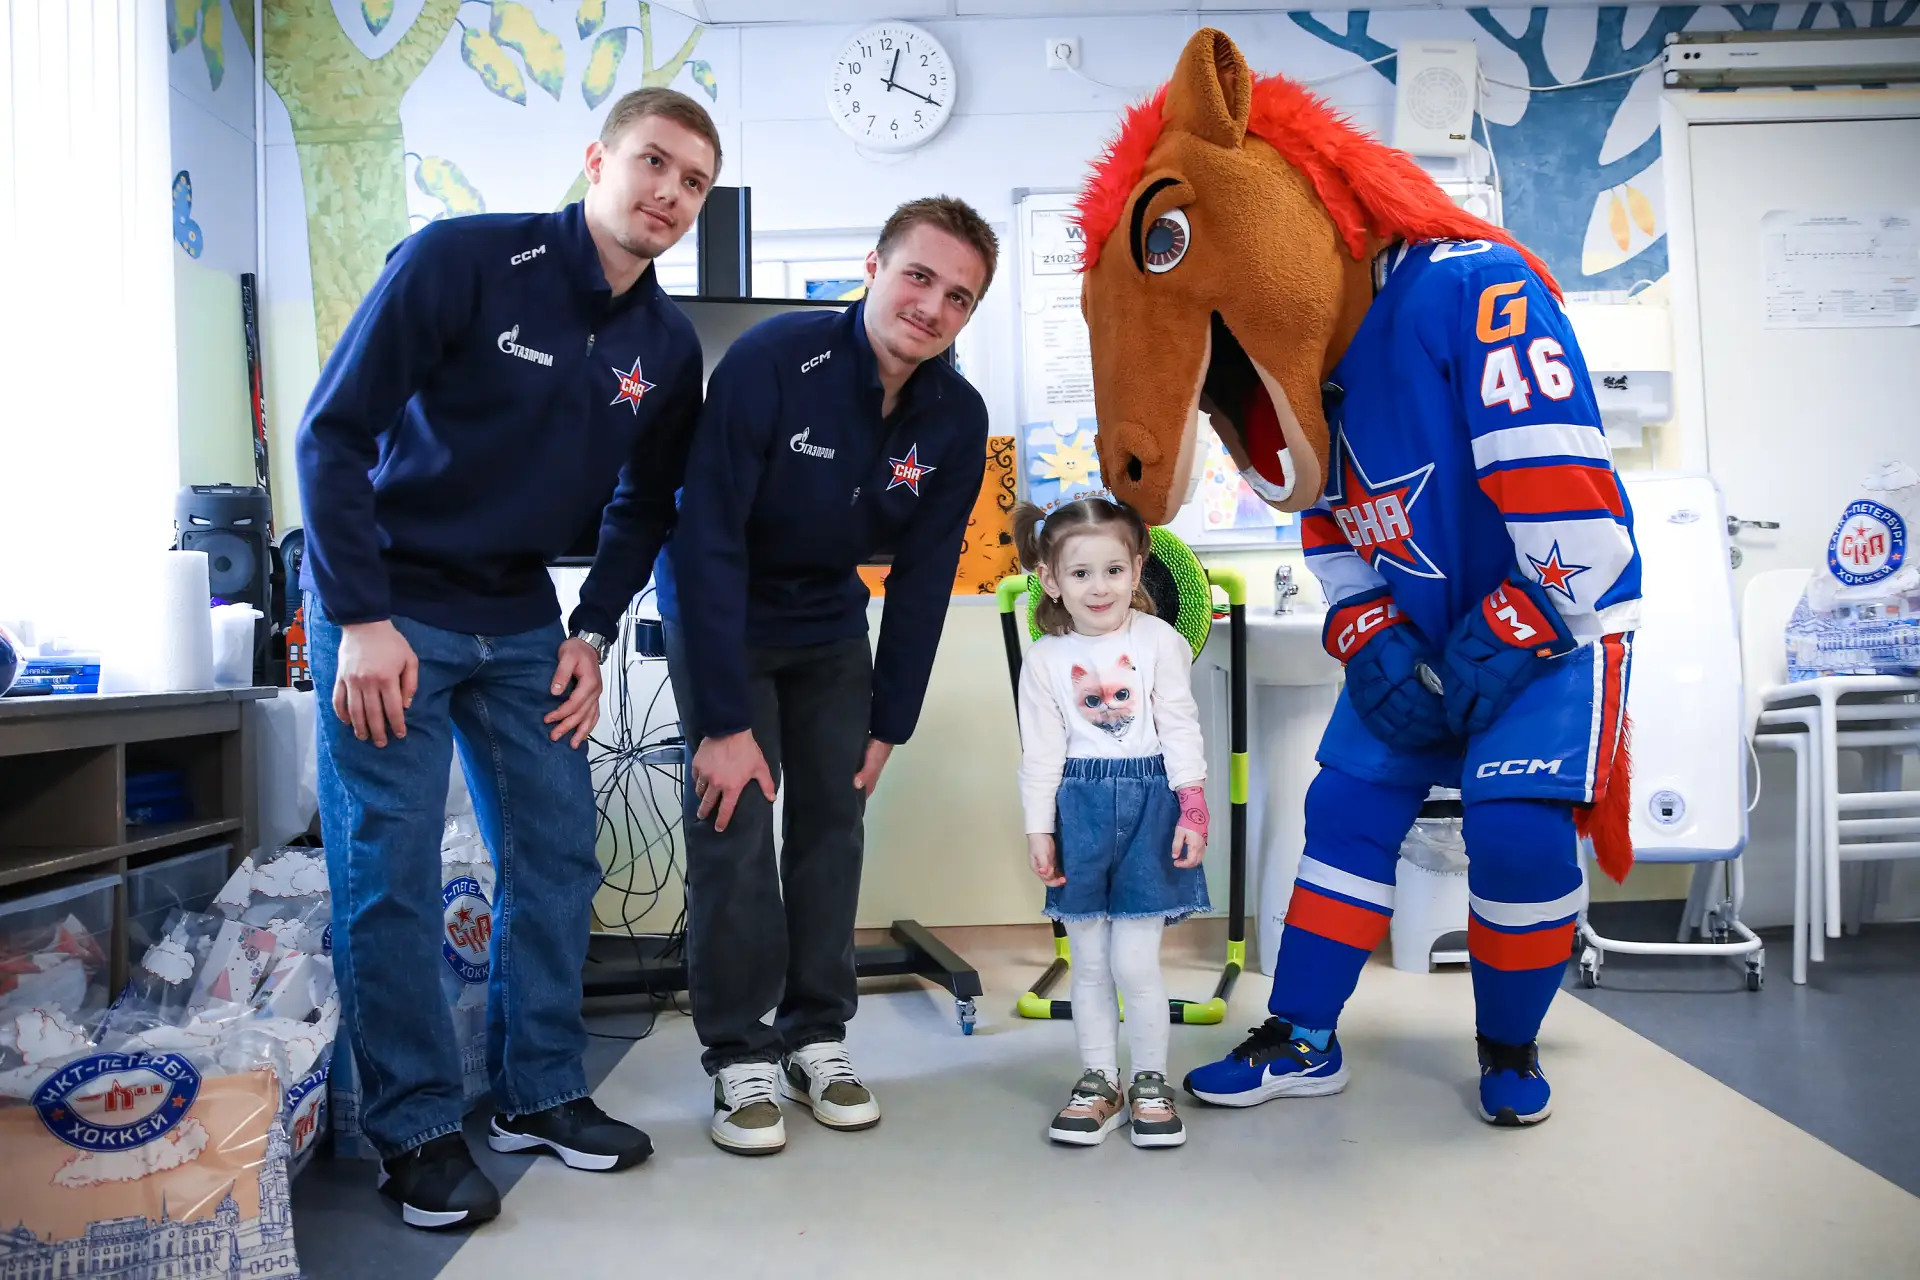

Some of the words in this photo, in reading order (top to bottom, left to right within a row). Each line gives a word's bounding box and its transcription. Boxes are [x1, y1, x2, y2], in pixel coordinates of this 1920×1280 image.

[880, 38, 893, 51] 12
[905, 41, 911, 53] 1
[861, 45, 872, 58] 11
[920, 54, 929, 67] 2
[848, 62, 861, 75] 10
[929, 73, 938, 86] 3
[843, 83, 852, 95] 9
[852, 101, 861, 113] 8
[867, 115, 876, 128] 7
[914, 110, 922, 123] 5
[890, 119, 898, 131] 6
[510, 244, 546, 266] CCM
[800, 350, 832, 374] CCM
[1480, 336, 1575, 415] 46
[1829, 503, 1903, 552] САНКТ-ПЕТЕРБУРГ
[1836, 564, 1894, 584] ХОККЕЙ
[1476, 759, 1563, 779] CCM
[459, 962, 489, 979] ХОКК
[67, 1113, 169, 1146] ХОККЕЙ
